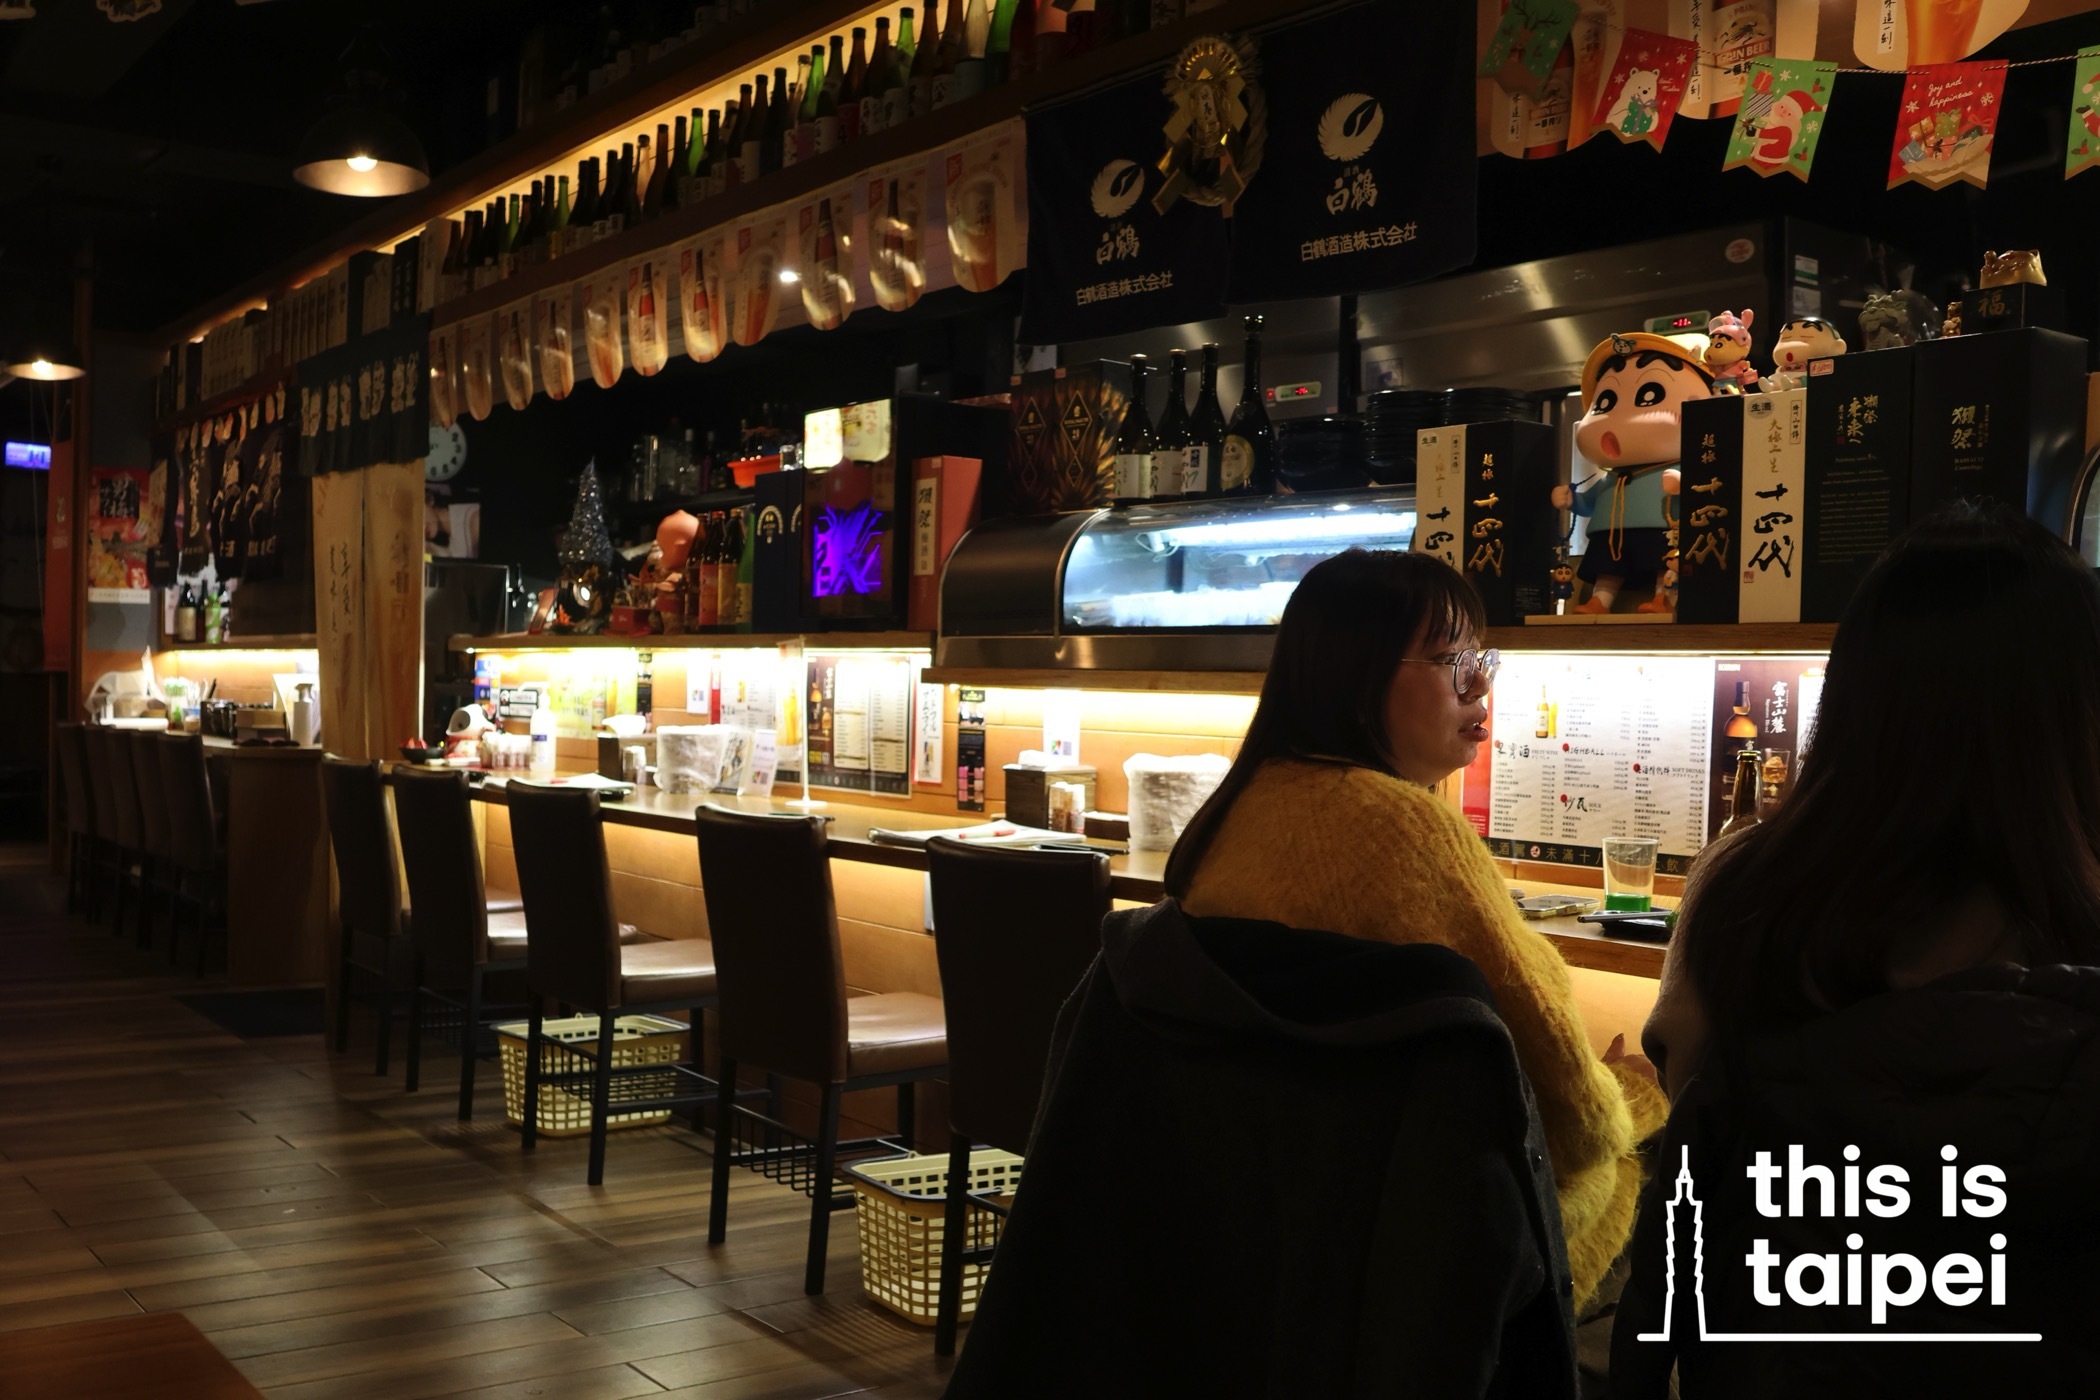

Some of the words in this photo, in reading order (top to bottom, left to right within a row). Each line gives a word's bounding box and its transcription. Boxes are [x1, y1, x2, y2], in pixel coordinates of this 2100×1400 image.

[1746, 39, 1771, 58] BEER
[1928, 82, 1944, 98] Joy
[1945, 75, 1964, 90] and
[1929, 90, 1974, 108] happiness
[1326, 168, 1378, 216] 白鶴
[1096, 223, 1141, 266] 白鶴
[1300, 221, 1418, 262] 白鶴酒造株式会社
[1075, 269, 1174, 307] 白鶴酒造株式会社
[1978, 289, 2006, 318] 福
[1769, 681, 1788, 734] 富士山麓
